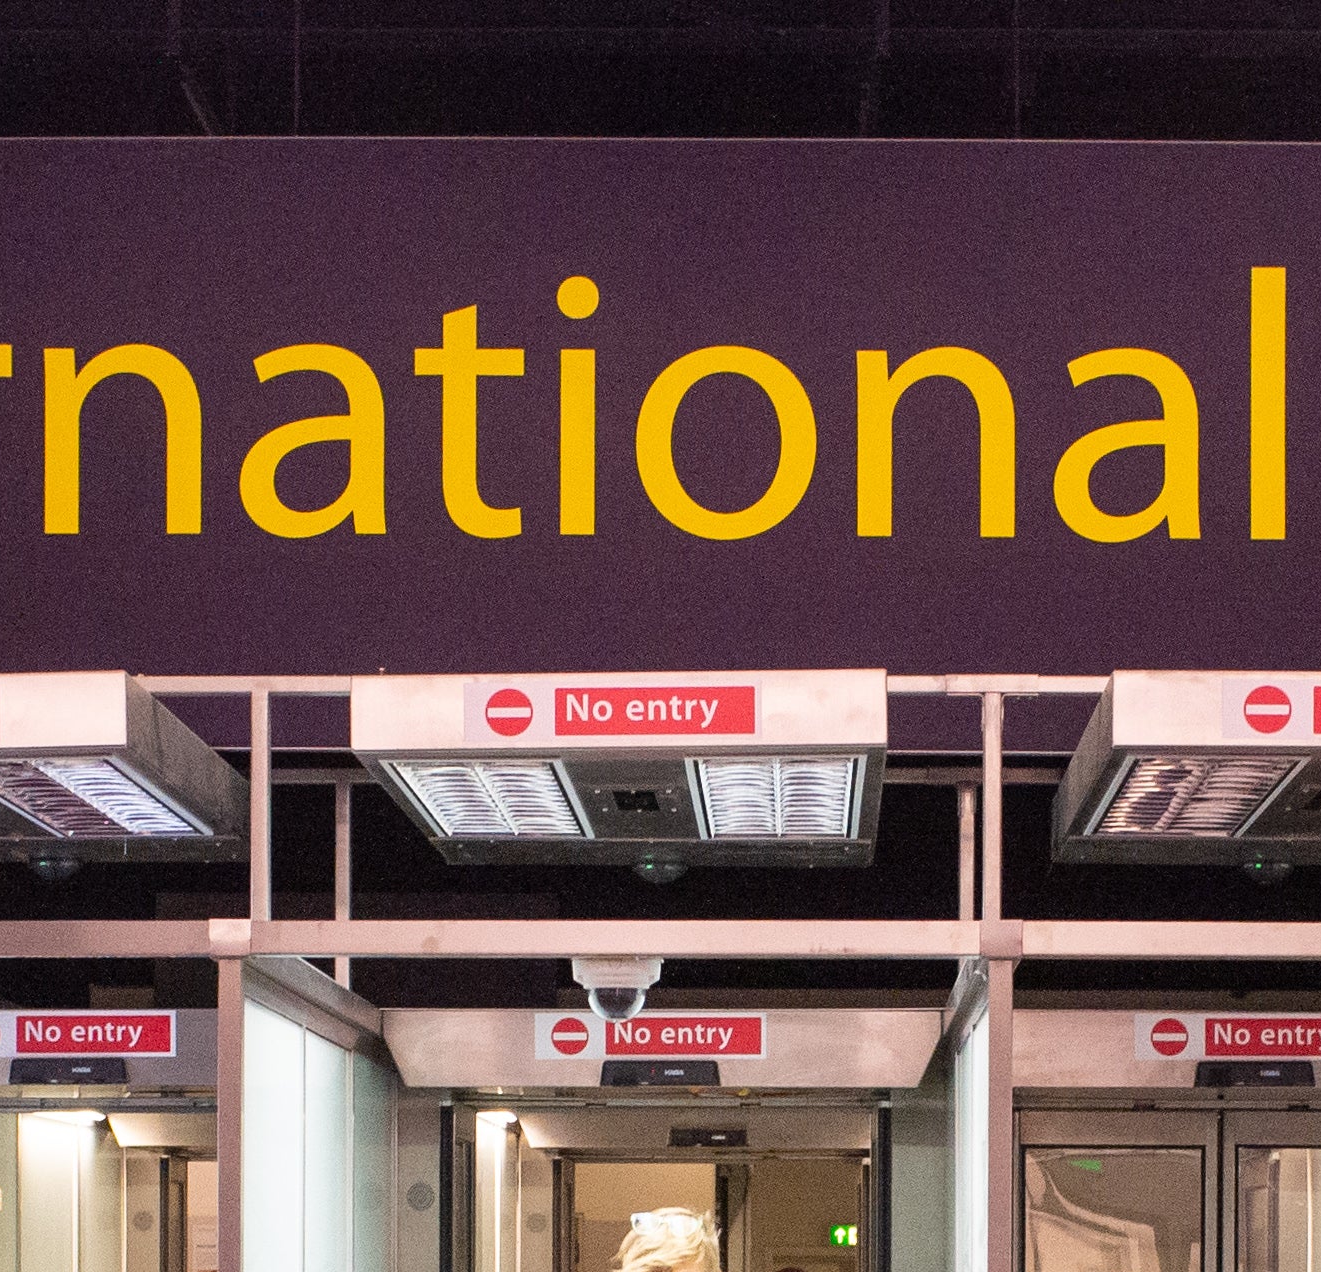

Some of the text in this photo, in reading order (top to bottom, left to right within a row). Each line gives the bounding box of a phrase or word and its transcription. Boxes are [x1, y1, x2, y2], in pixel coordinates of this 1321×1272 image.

[566, 693, 719, 729] No entry
[25, 1020, 143, 1048] No entry
[614, 1021, 734, 1050] No entry
[1214, 1023, 1251, 1045] No
